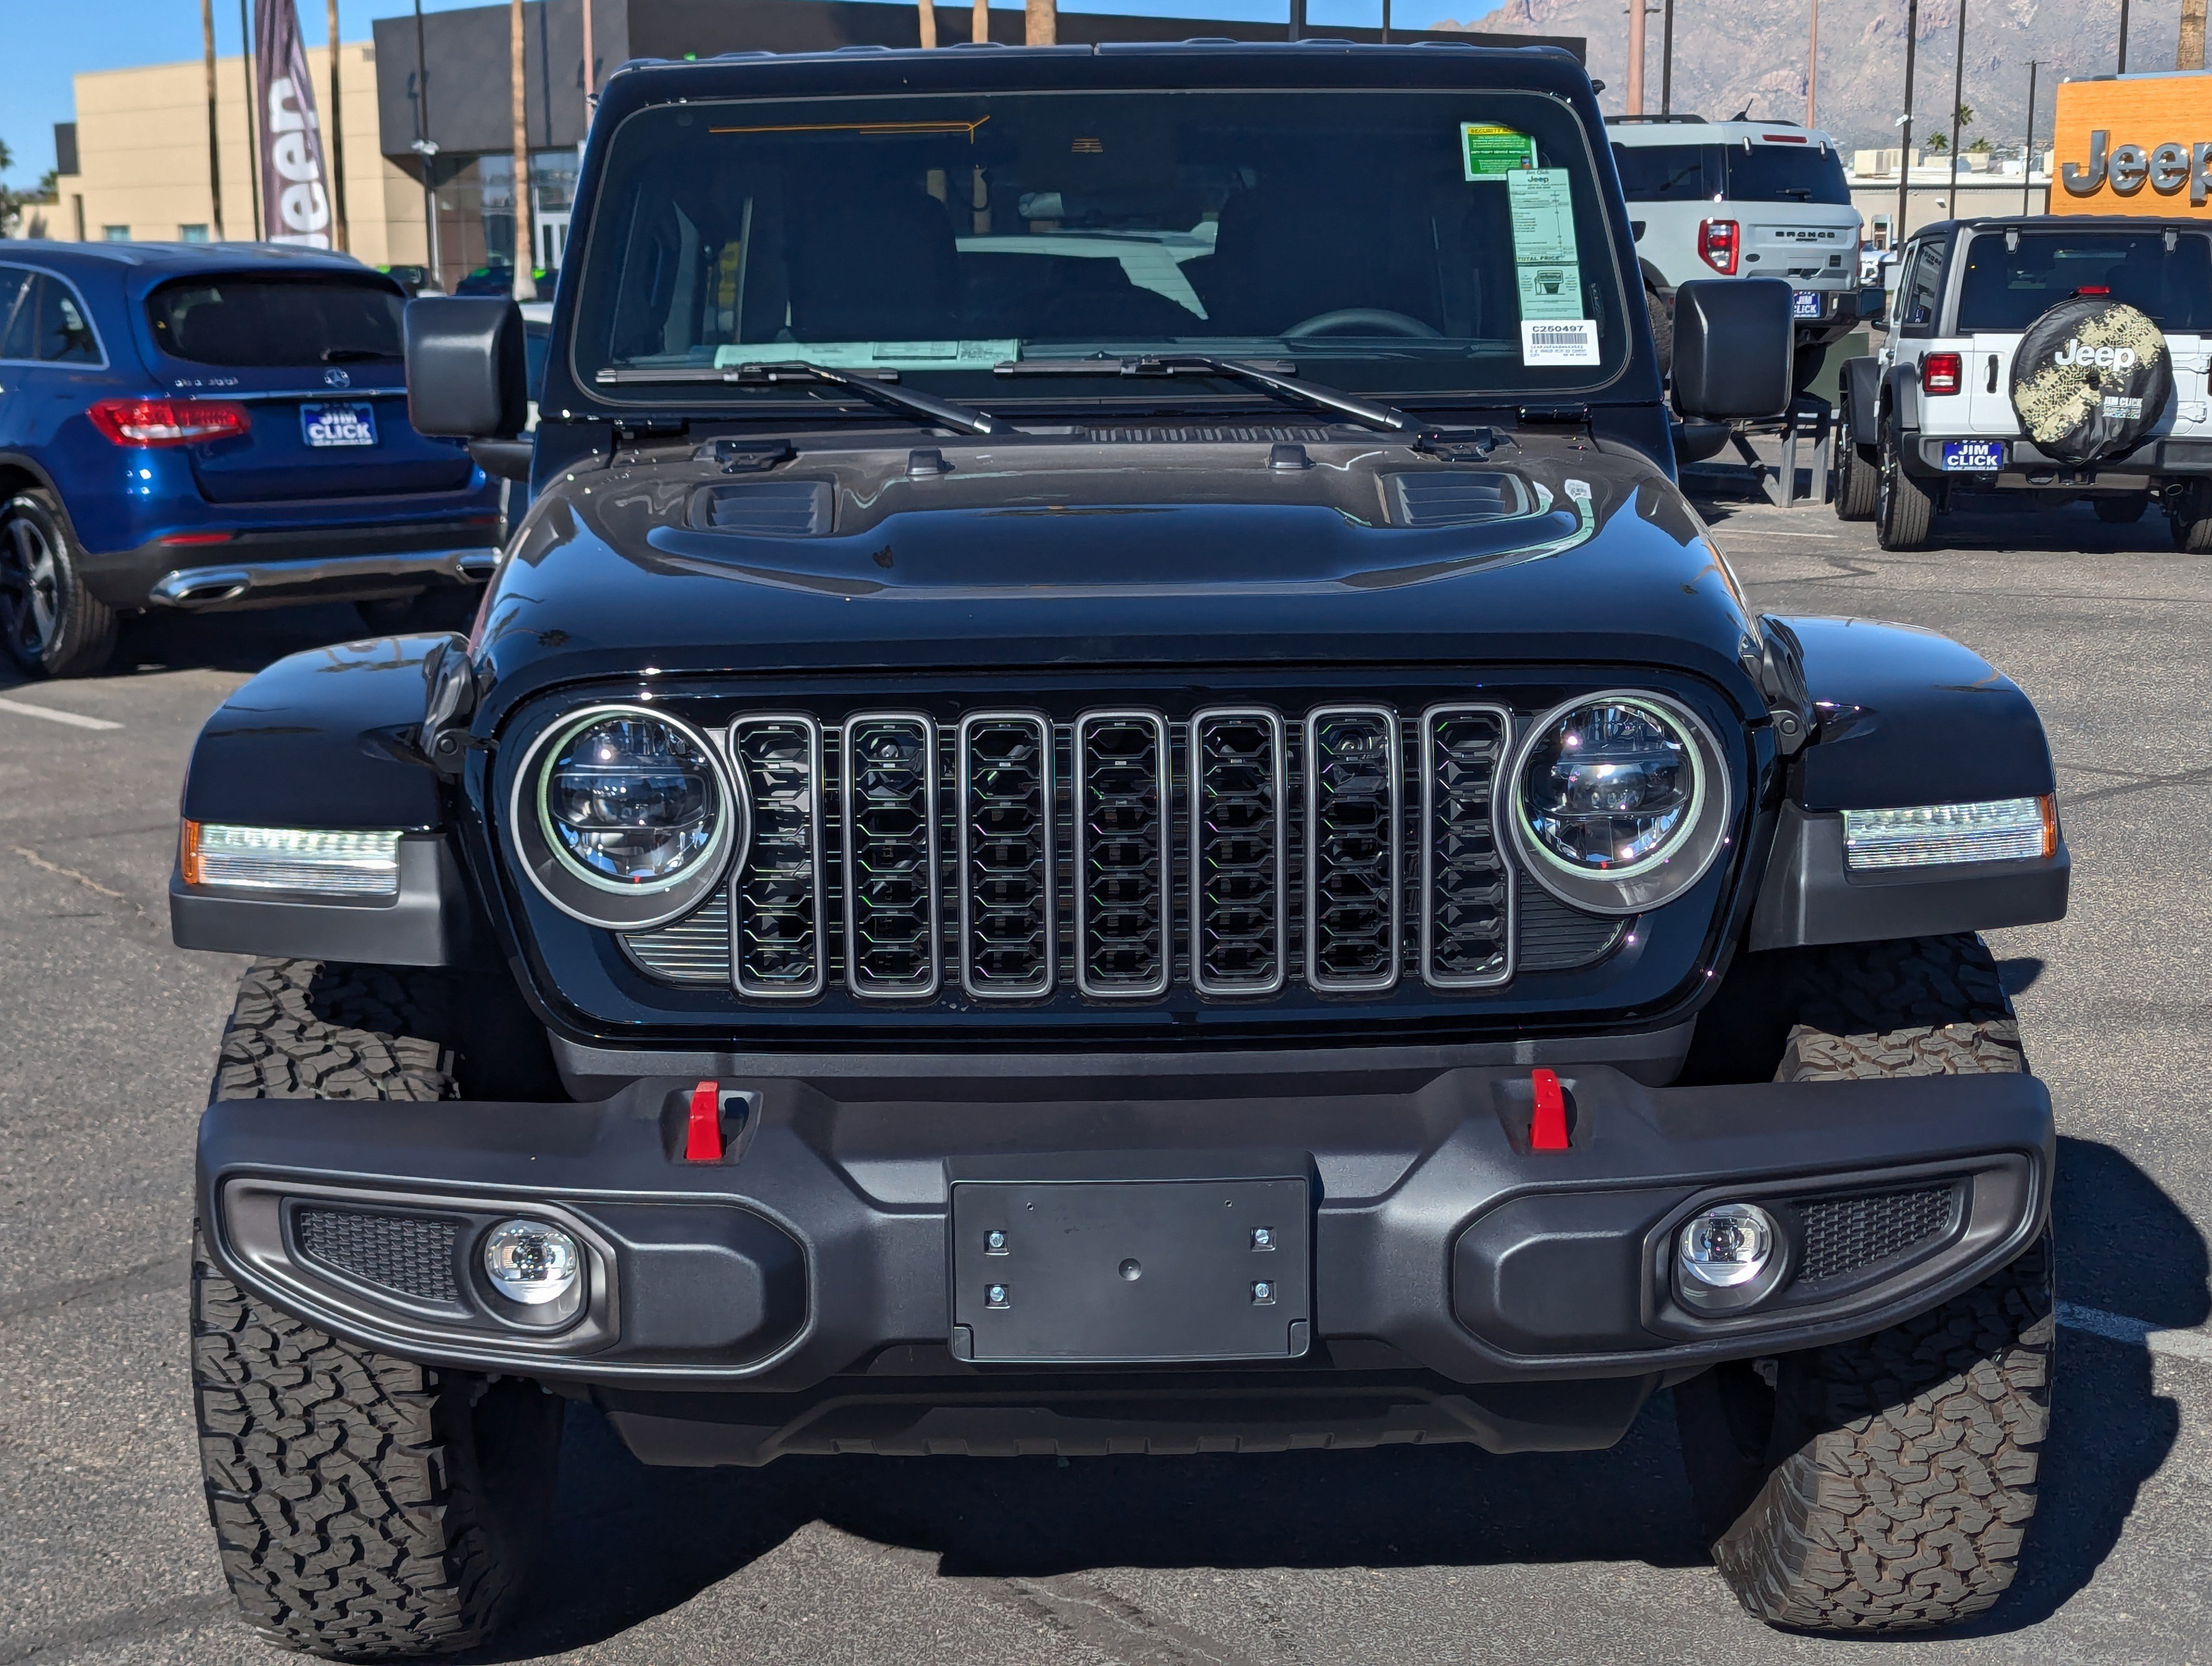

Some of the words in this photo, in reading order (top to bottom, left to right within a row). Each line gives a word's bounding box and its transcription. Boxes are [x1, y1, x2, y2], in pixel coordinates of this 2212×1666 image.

[2055, 338, 2135, 371] Jeep
[318, 411, 357, 425] JIM
[308, 422, 371, 439] CLICK
[1958, 445, 1989, 455] JIM
[1947, 455, 1998, 466] CLICK
